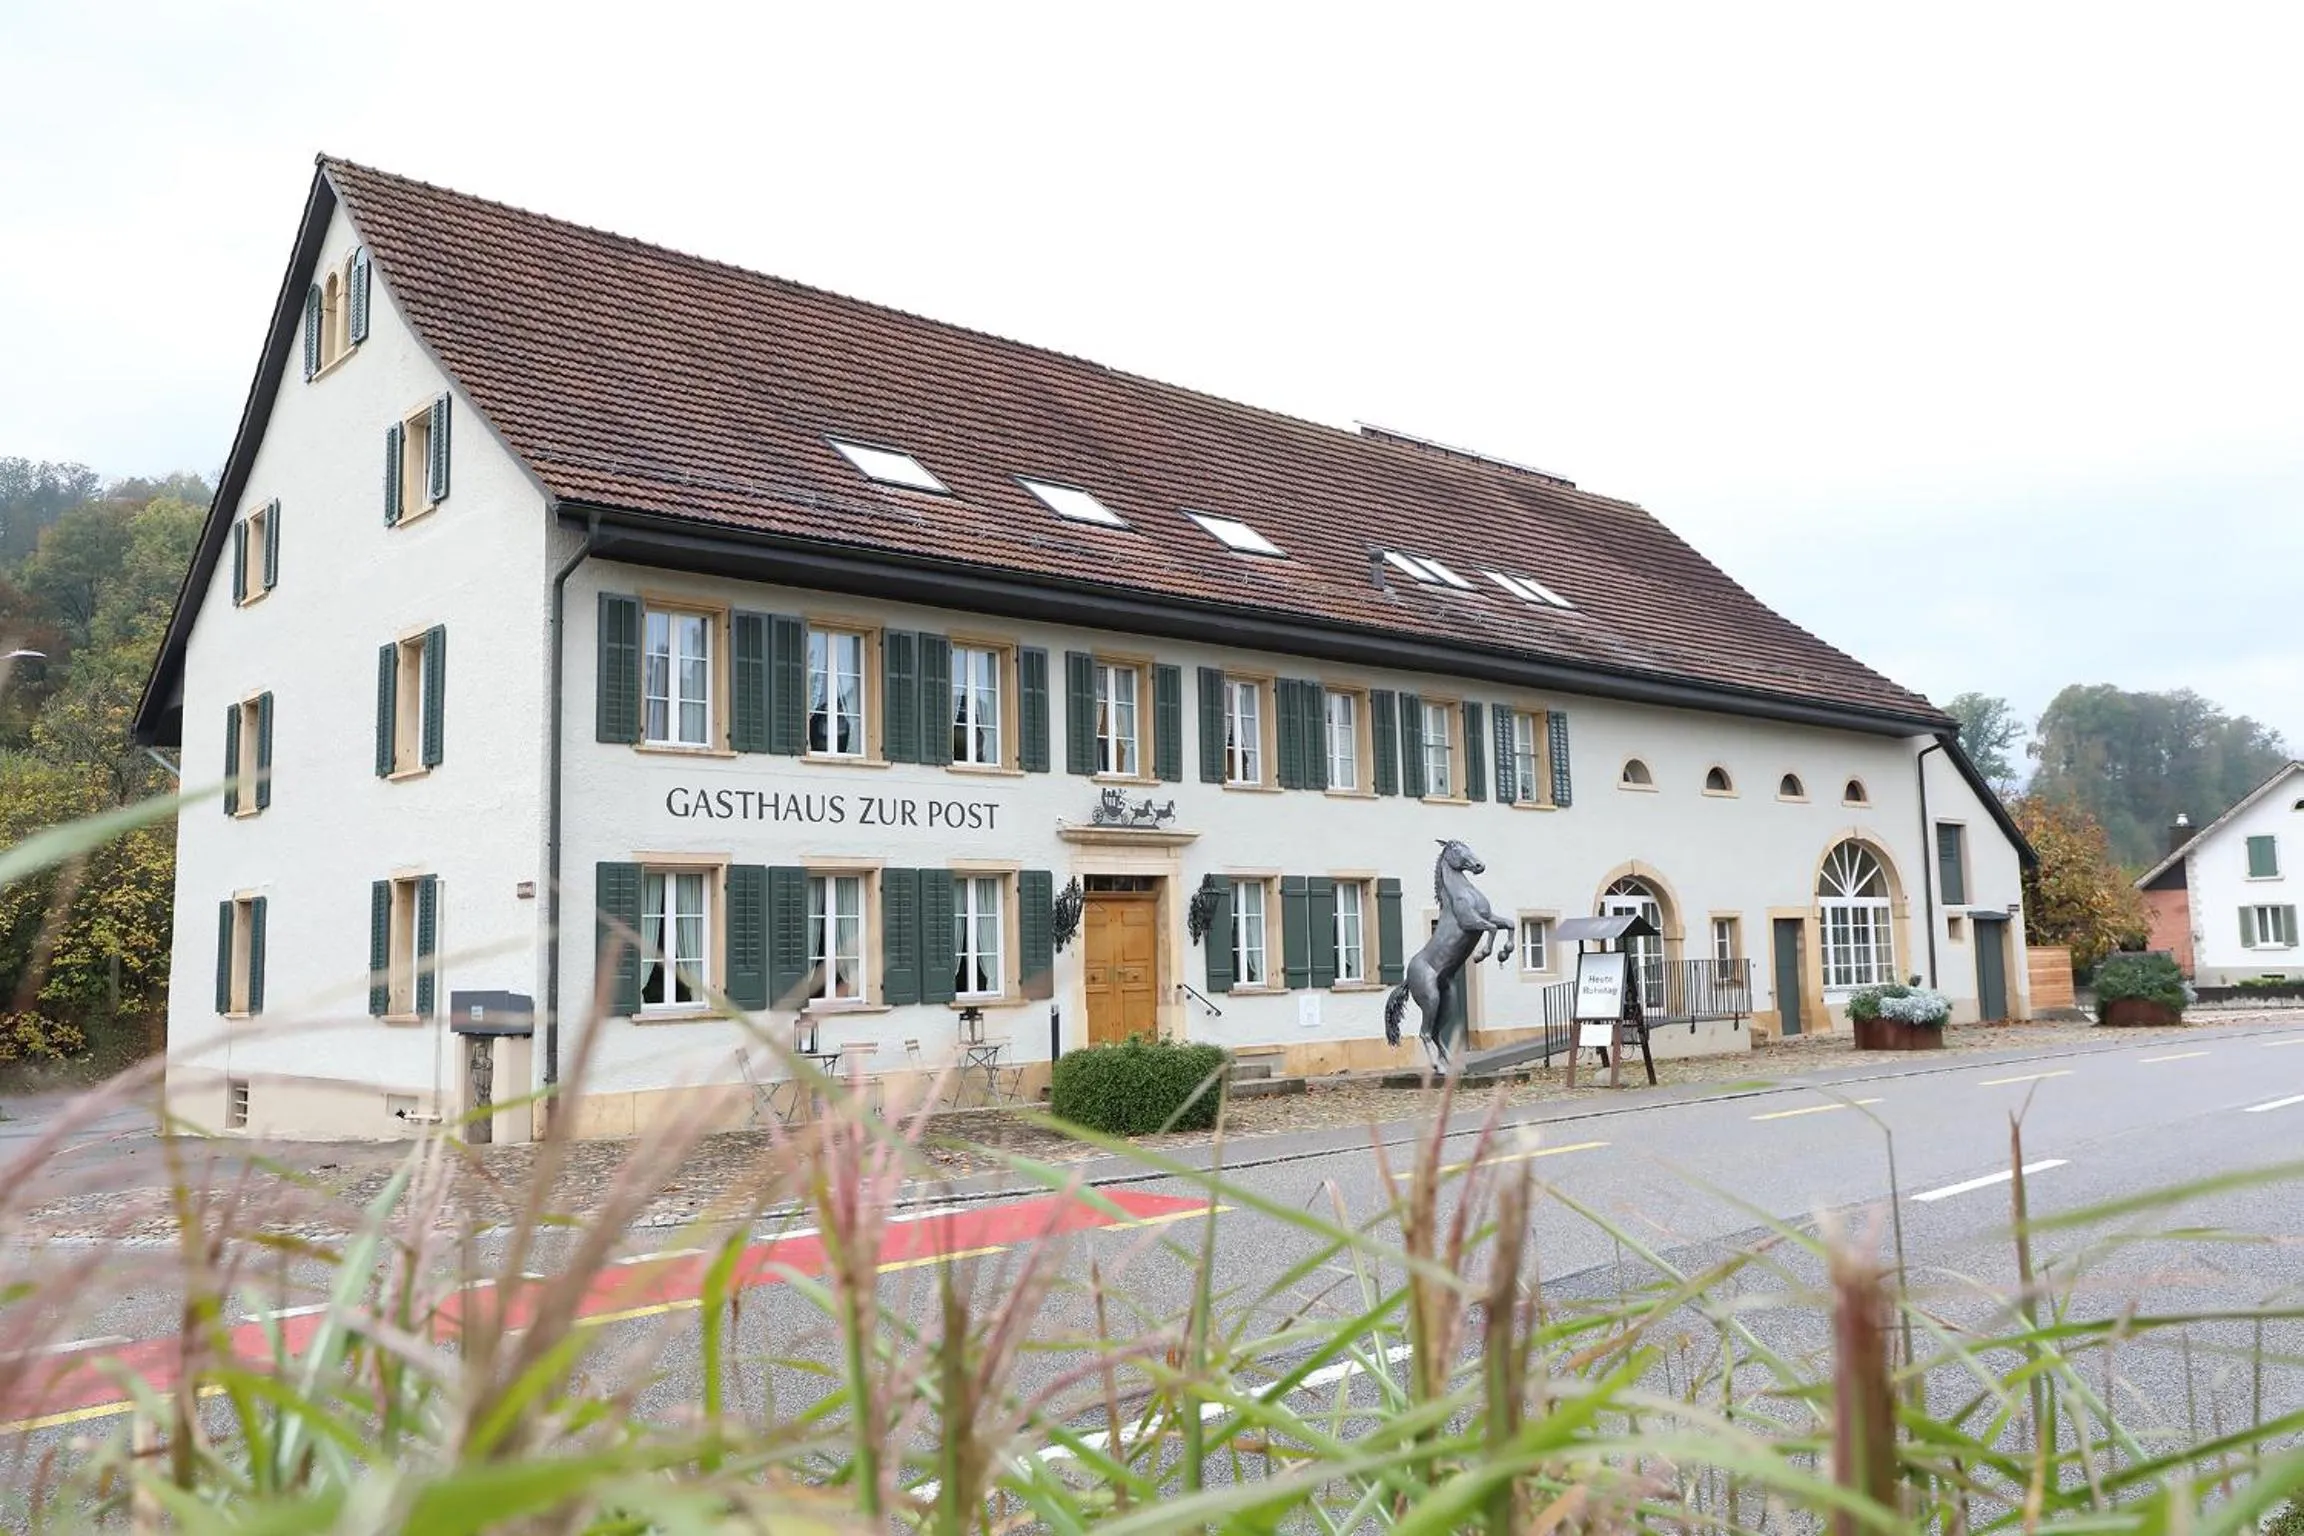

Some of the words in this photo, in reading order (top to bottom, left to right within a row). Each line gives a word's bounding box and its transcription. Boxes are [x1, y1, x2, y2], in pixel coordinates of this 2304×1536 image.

[666, 787, 845, 823] GASTHAUS
[859, 797, 917, 826] ZUR
[929, 801, 1000, 829] POST
